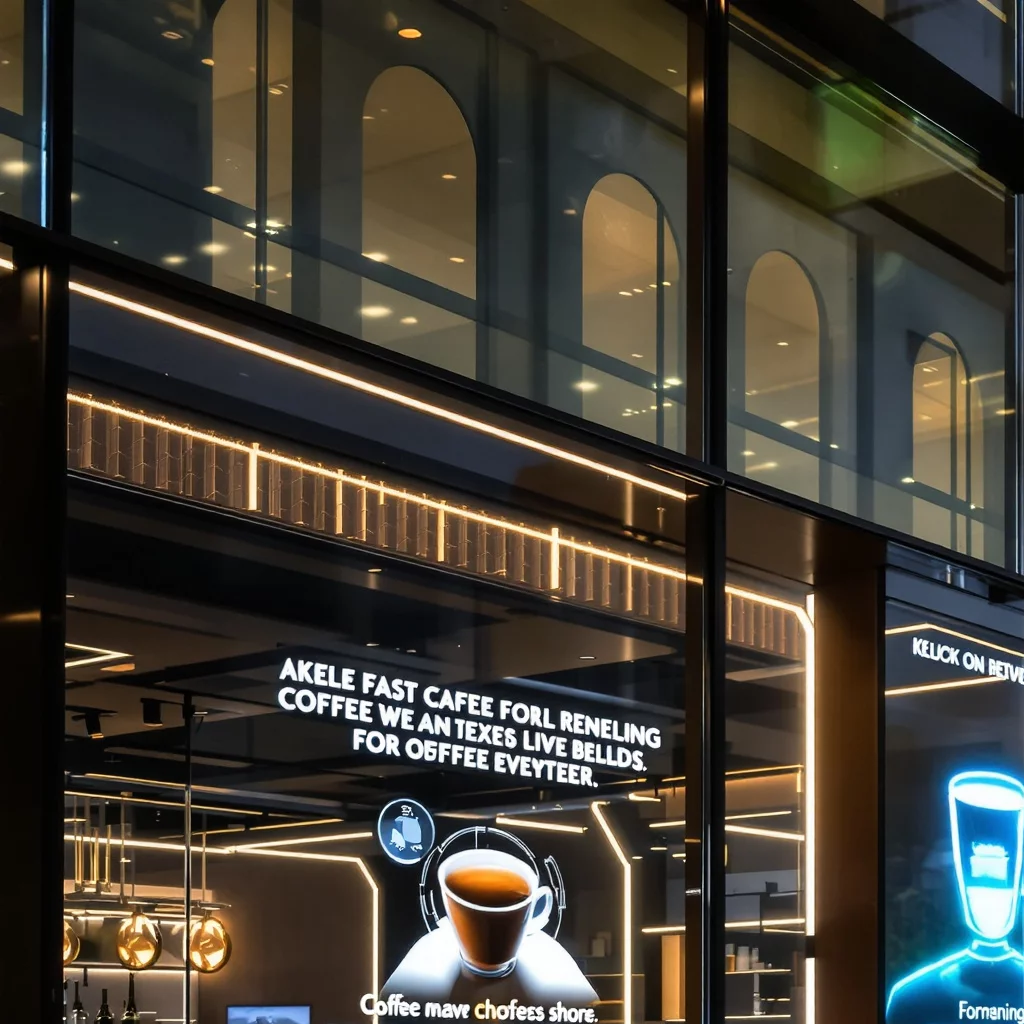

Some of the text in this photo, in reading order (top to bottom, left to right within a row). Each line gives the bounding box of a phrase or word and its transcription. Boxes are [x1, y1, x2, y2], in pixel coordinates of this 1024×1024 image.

[962, 651, 985, 674] ON
[277, 686, 374, 723] COFFEE
[378, 703, 414, 731] WE
[417, 711, 451, 741] AN
[454, 718, 518, 750] TEXES
[523, 730, 568, 758] LIVE
[278, 657, 662, 749] AKELE FAST CAFEE FORL RENELING
[352, 728, 401, 757] FOR
[494, 751, 599, 788] EVEYTEER.
[359, 993, 421, 1017] Coffee
